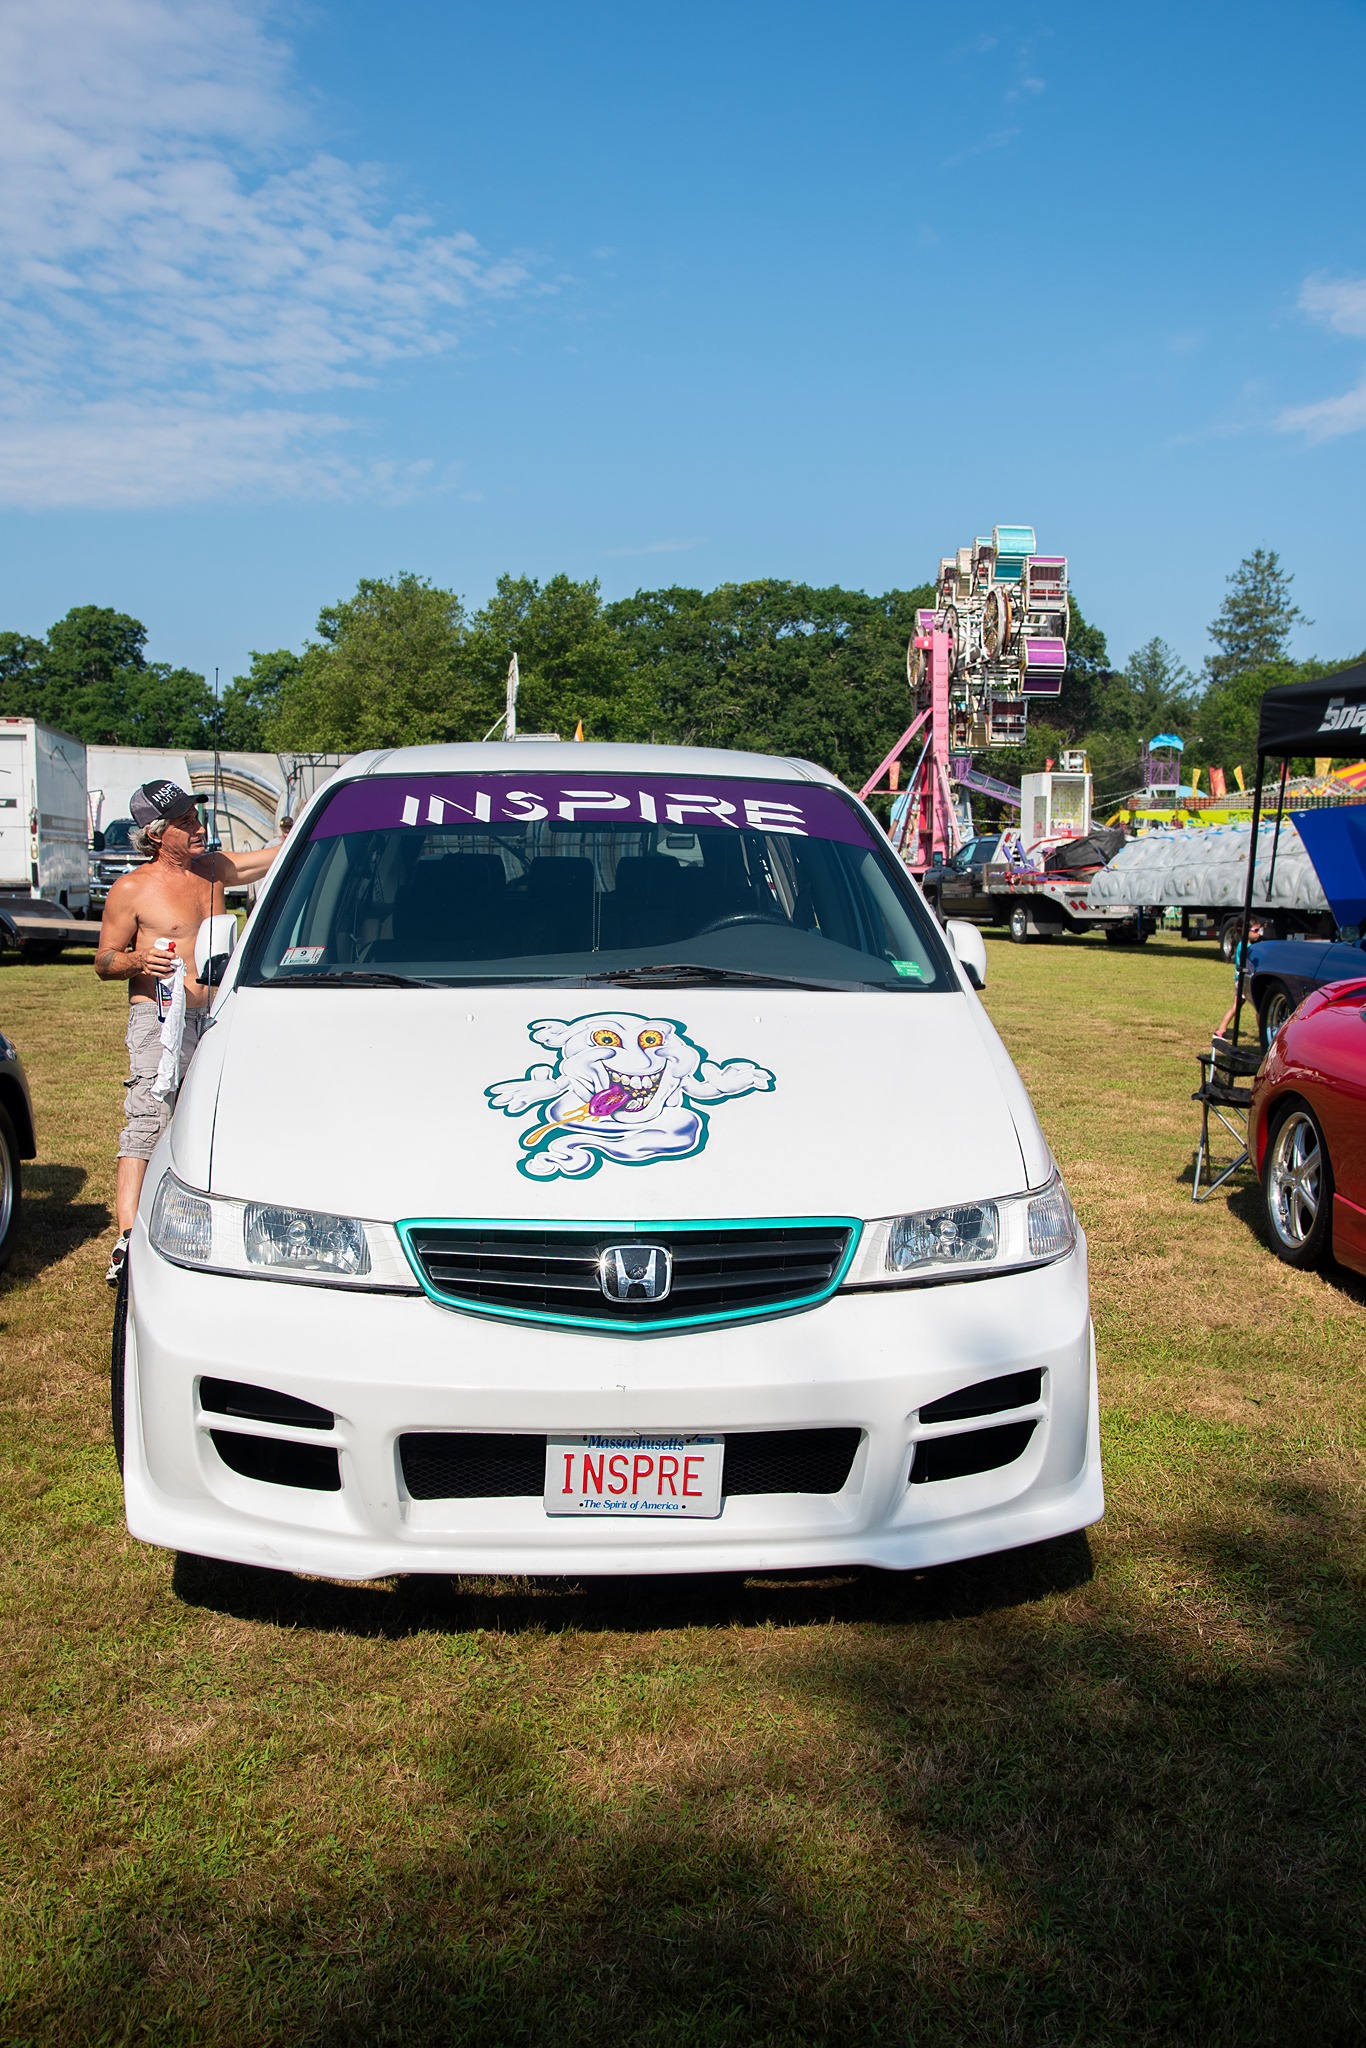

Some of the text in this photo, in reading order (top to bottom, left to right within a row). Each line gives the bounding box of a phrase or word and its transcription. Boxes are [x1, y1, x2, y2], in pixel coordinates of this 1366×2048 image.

[1316, 697, 1366, 735] Sna
[160, 791, 177, 808] AUTO
[400, 790, 809, 836] INSPIRE
[588, 1435, 684, 1451] Massachusetts
[562, 1453, 704, 1496] INSPRE
[584, 1499, 679, 1510] The Spirit of America
